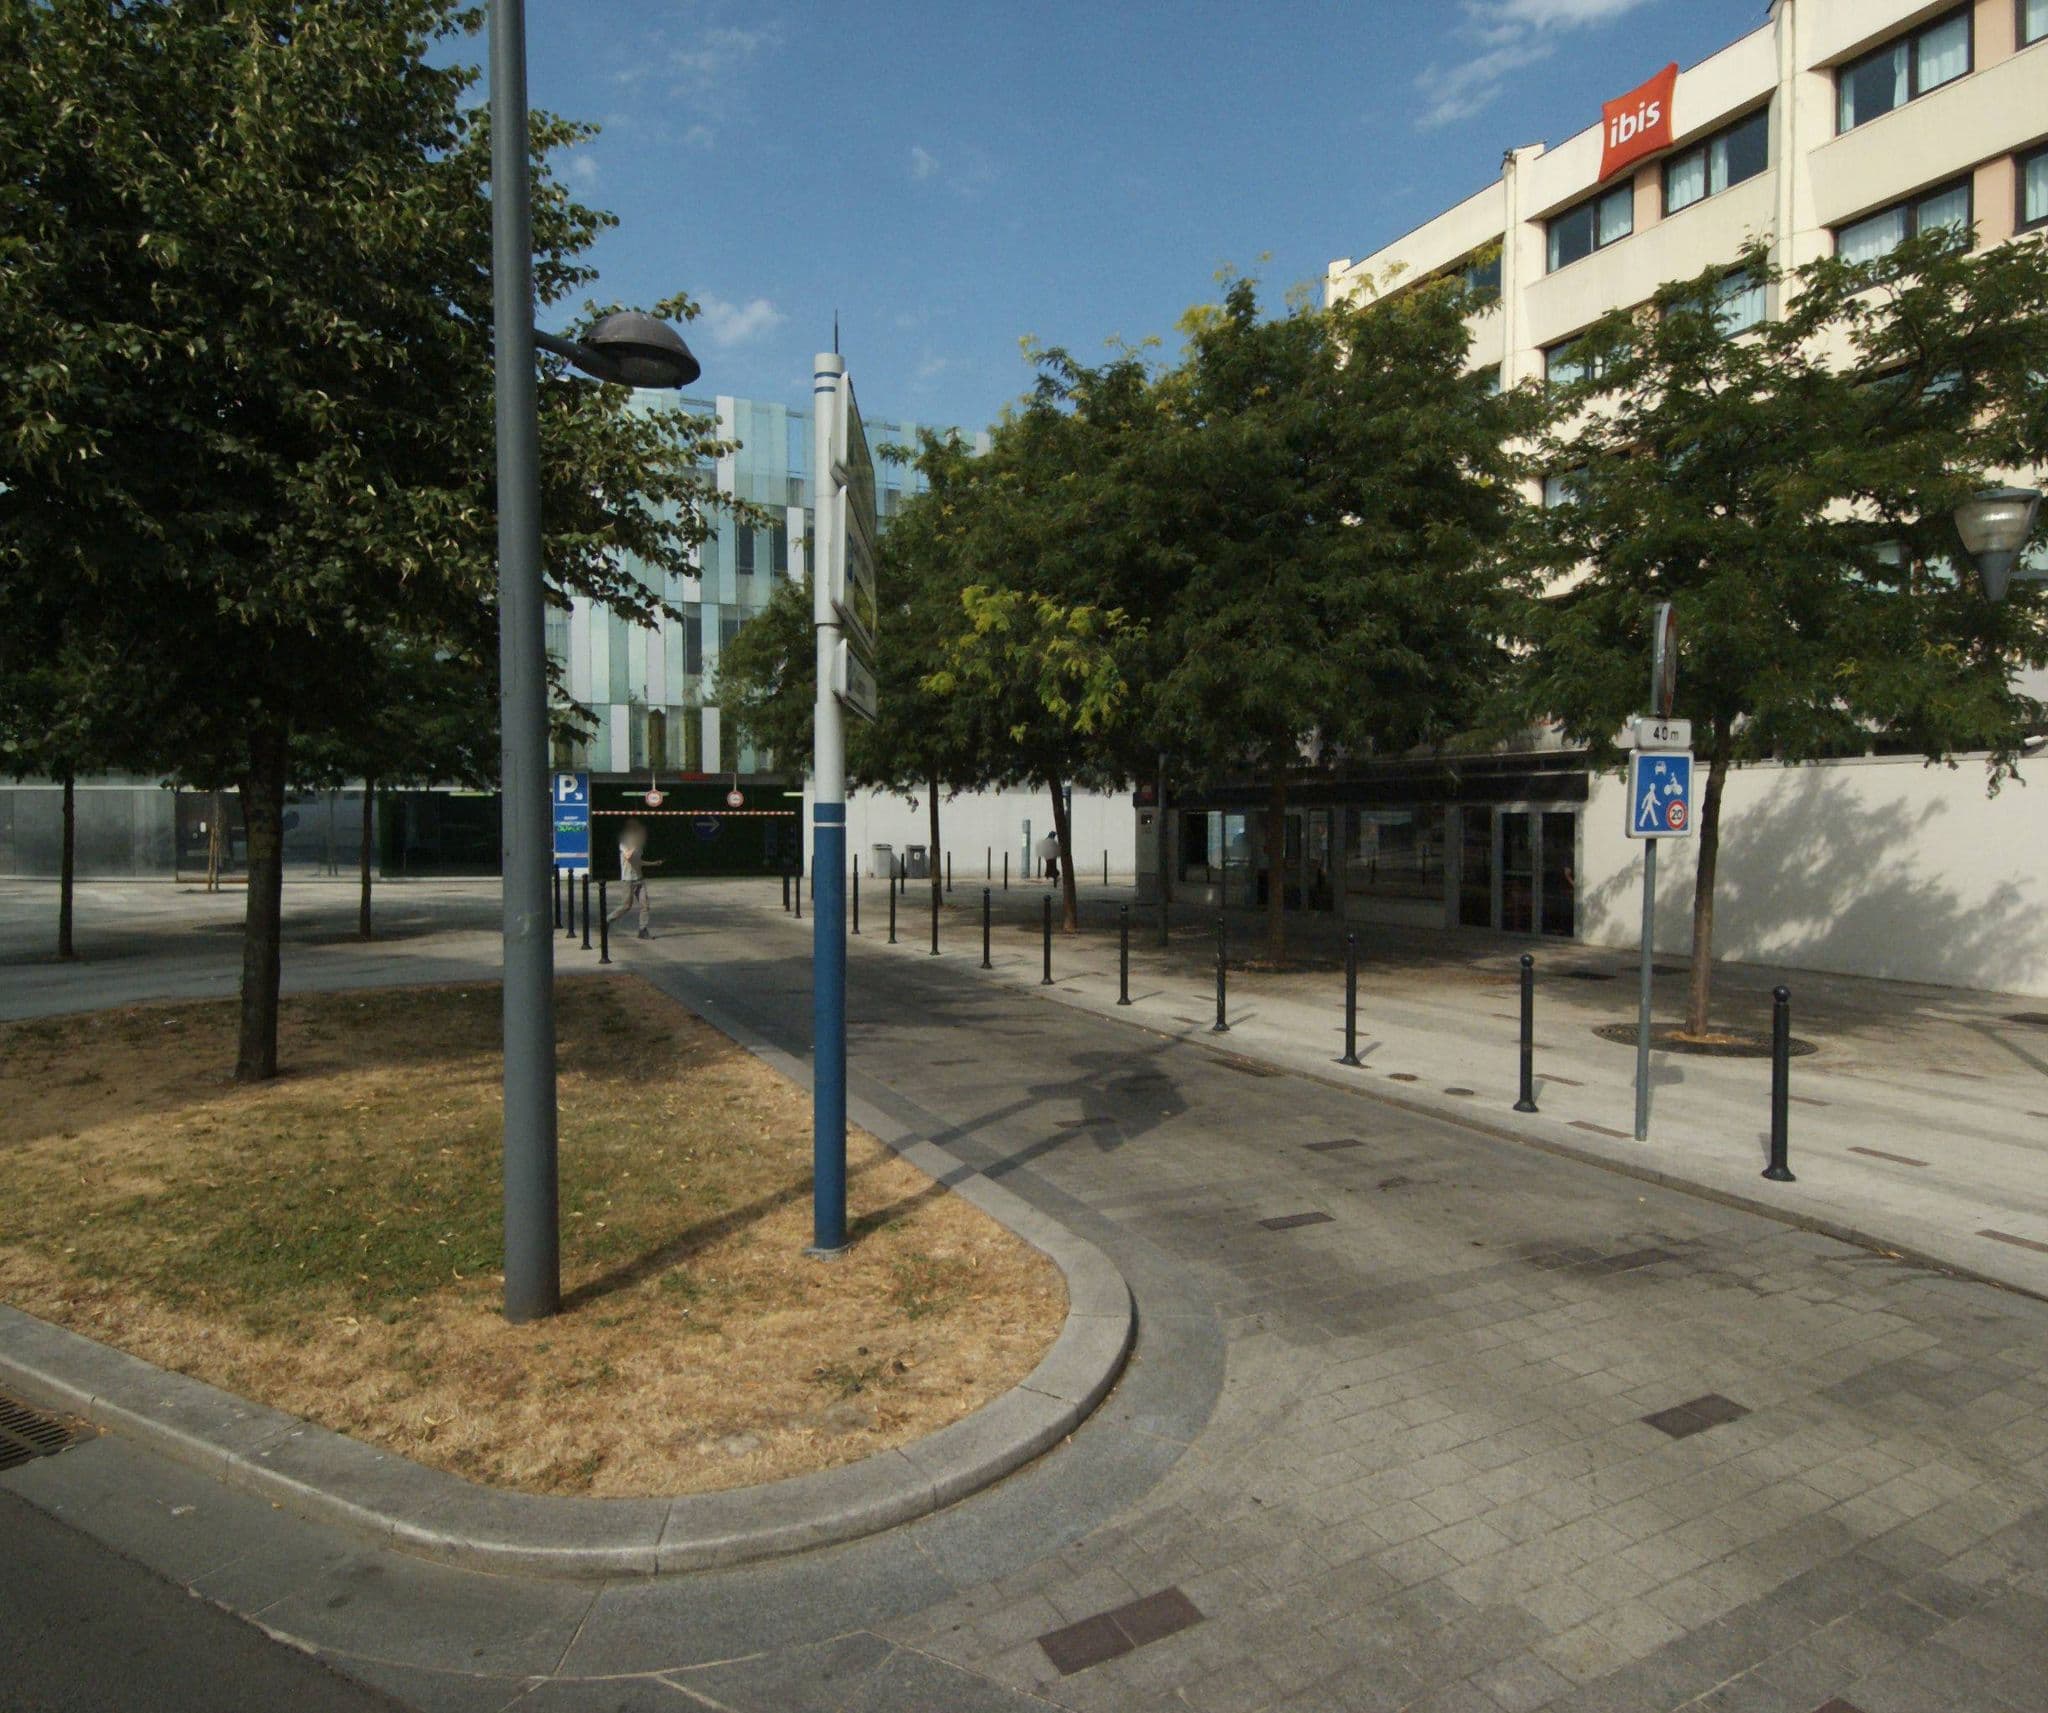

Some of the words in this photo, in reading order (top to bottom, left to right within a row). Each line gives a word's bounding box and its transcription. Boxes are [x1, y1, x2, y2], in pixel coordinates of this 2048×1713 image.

[1610, 100, 1661, 148] ibis
[559, 774, 579, 801] P
[1671, 808, 1683, 820] 20
